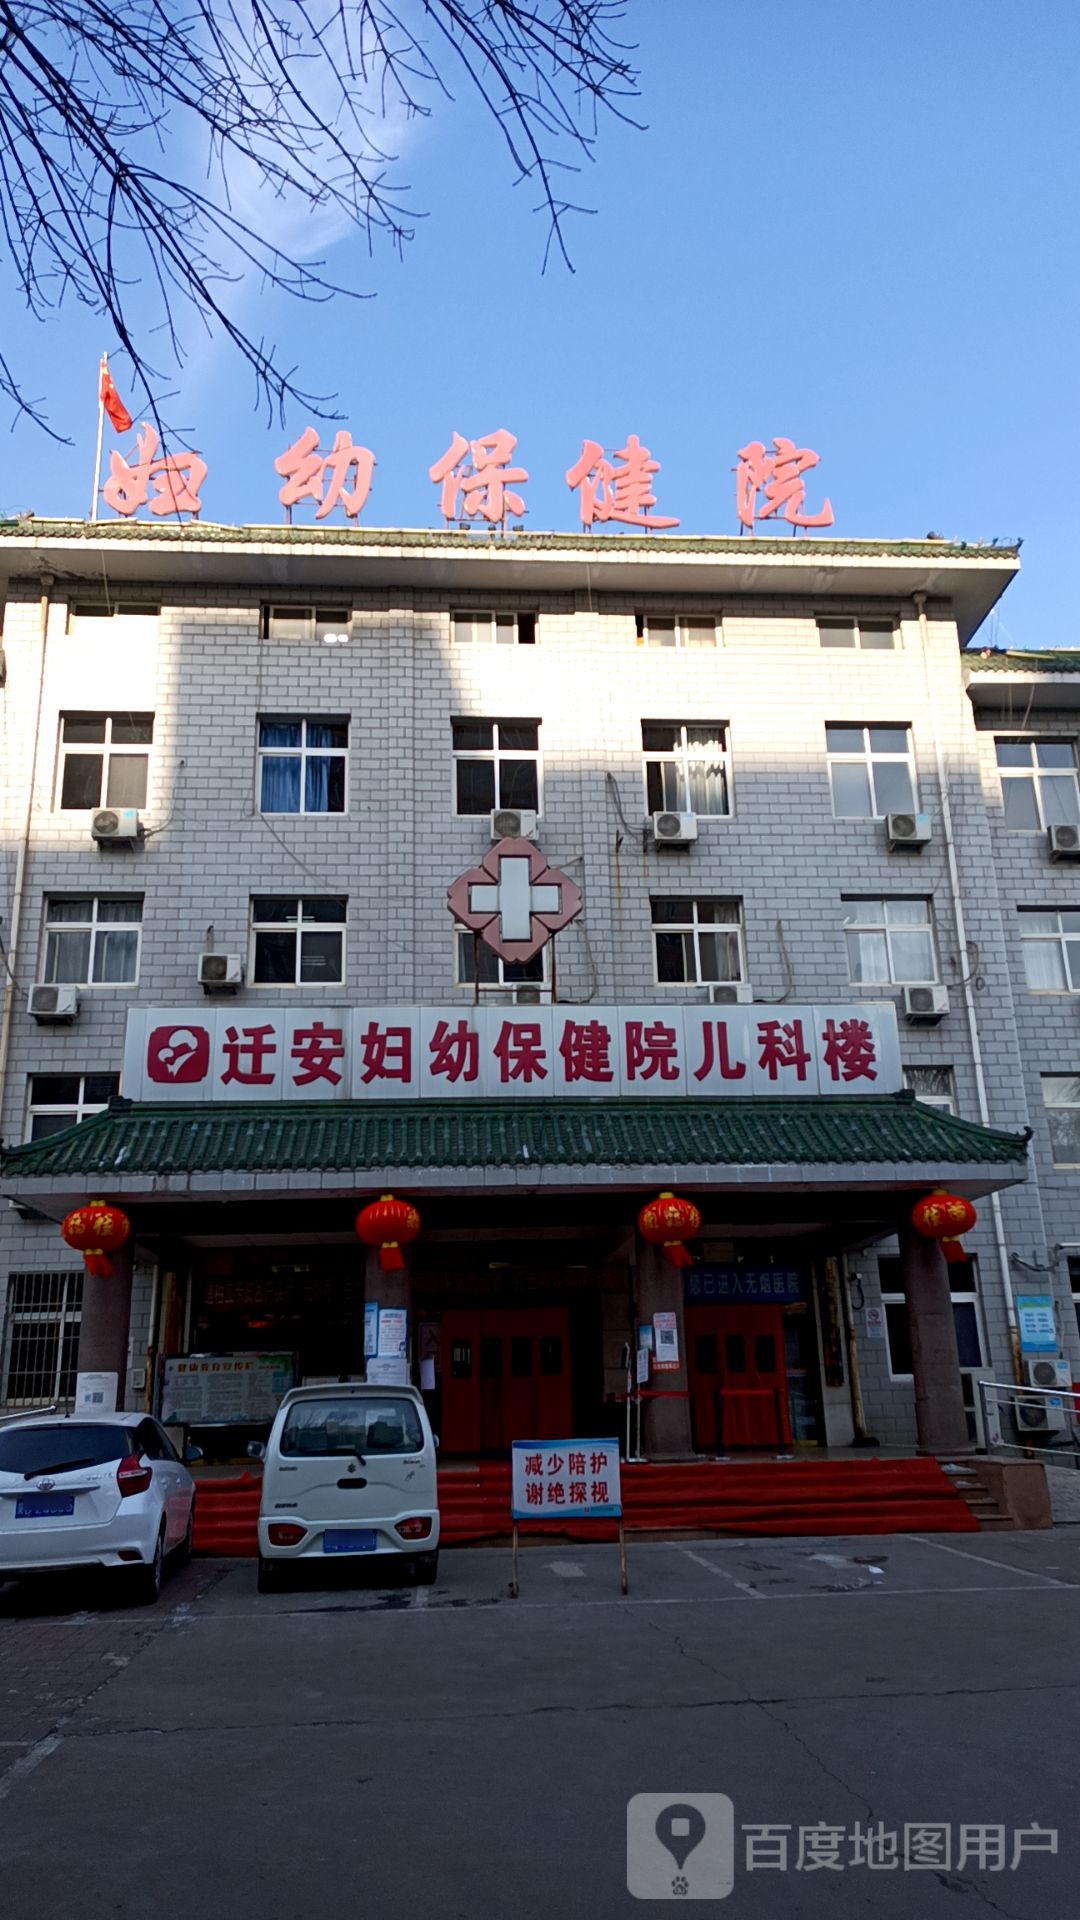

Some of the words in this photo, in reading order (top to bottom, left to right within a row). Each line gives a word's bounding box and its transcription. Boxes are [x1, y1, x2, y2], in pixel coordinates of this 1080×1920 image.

[103, 422, 834, 529] 妇幼保健院
[220, 1018, 878, 1086] 迁安妇幼保健院儿科楼
[689, 1272, 800, 1295] 您已进入无烟医院
[525, 1452, 608, 1476] 减少陪护
[525, 1480, 610, 1505] 谢绝探视
